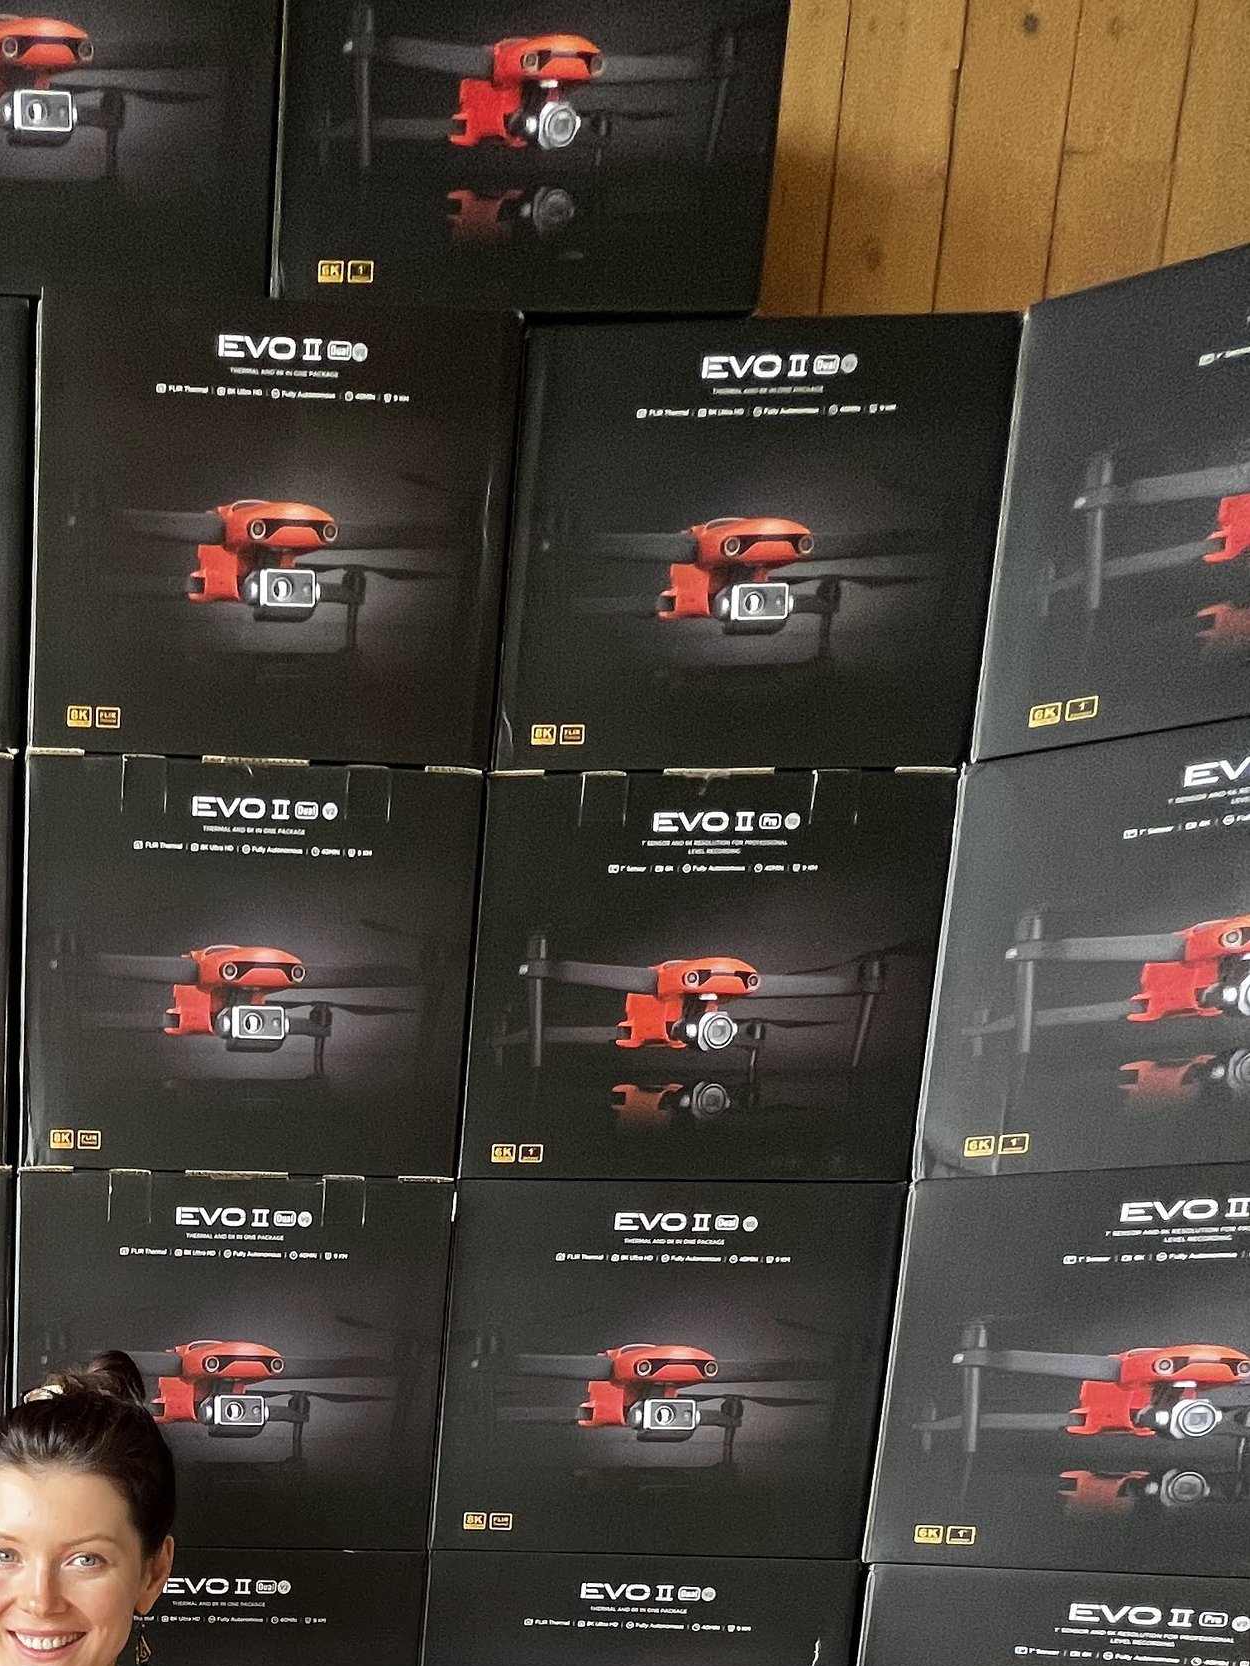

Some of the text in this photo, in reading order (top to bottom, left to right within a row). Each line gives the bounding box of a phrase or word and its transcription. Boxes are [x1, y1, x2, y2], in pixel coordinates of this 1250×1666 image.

[218, 335, 296, 360] EVO
[702, 354, 782, 378] EVO
[1184, 757, 1250, 787] EV
[192, 796, 265, 818] EVO
[653, 812, 729, 832] EVO
[761, 815, 779, 829] Pro
[968, 1139, 992, 1152] 6K
[176, 1207, 246, 1226] EVO
[275, 1212, 295, 1225] Dual
[1120, 1199, 1218, 1222] EVO
[614, 1213, 687, 1231] EVO
[163, 1577, 230, 1595] EVO
[257, 1582, 275, 1592] Dual
[580, 1583, 650, 1600] EVO
[1069, 1603, 1161, 1625] EVO
[1202, 1614, 1225, 1625] Pro
